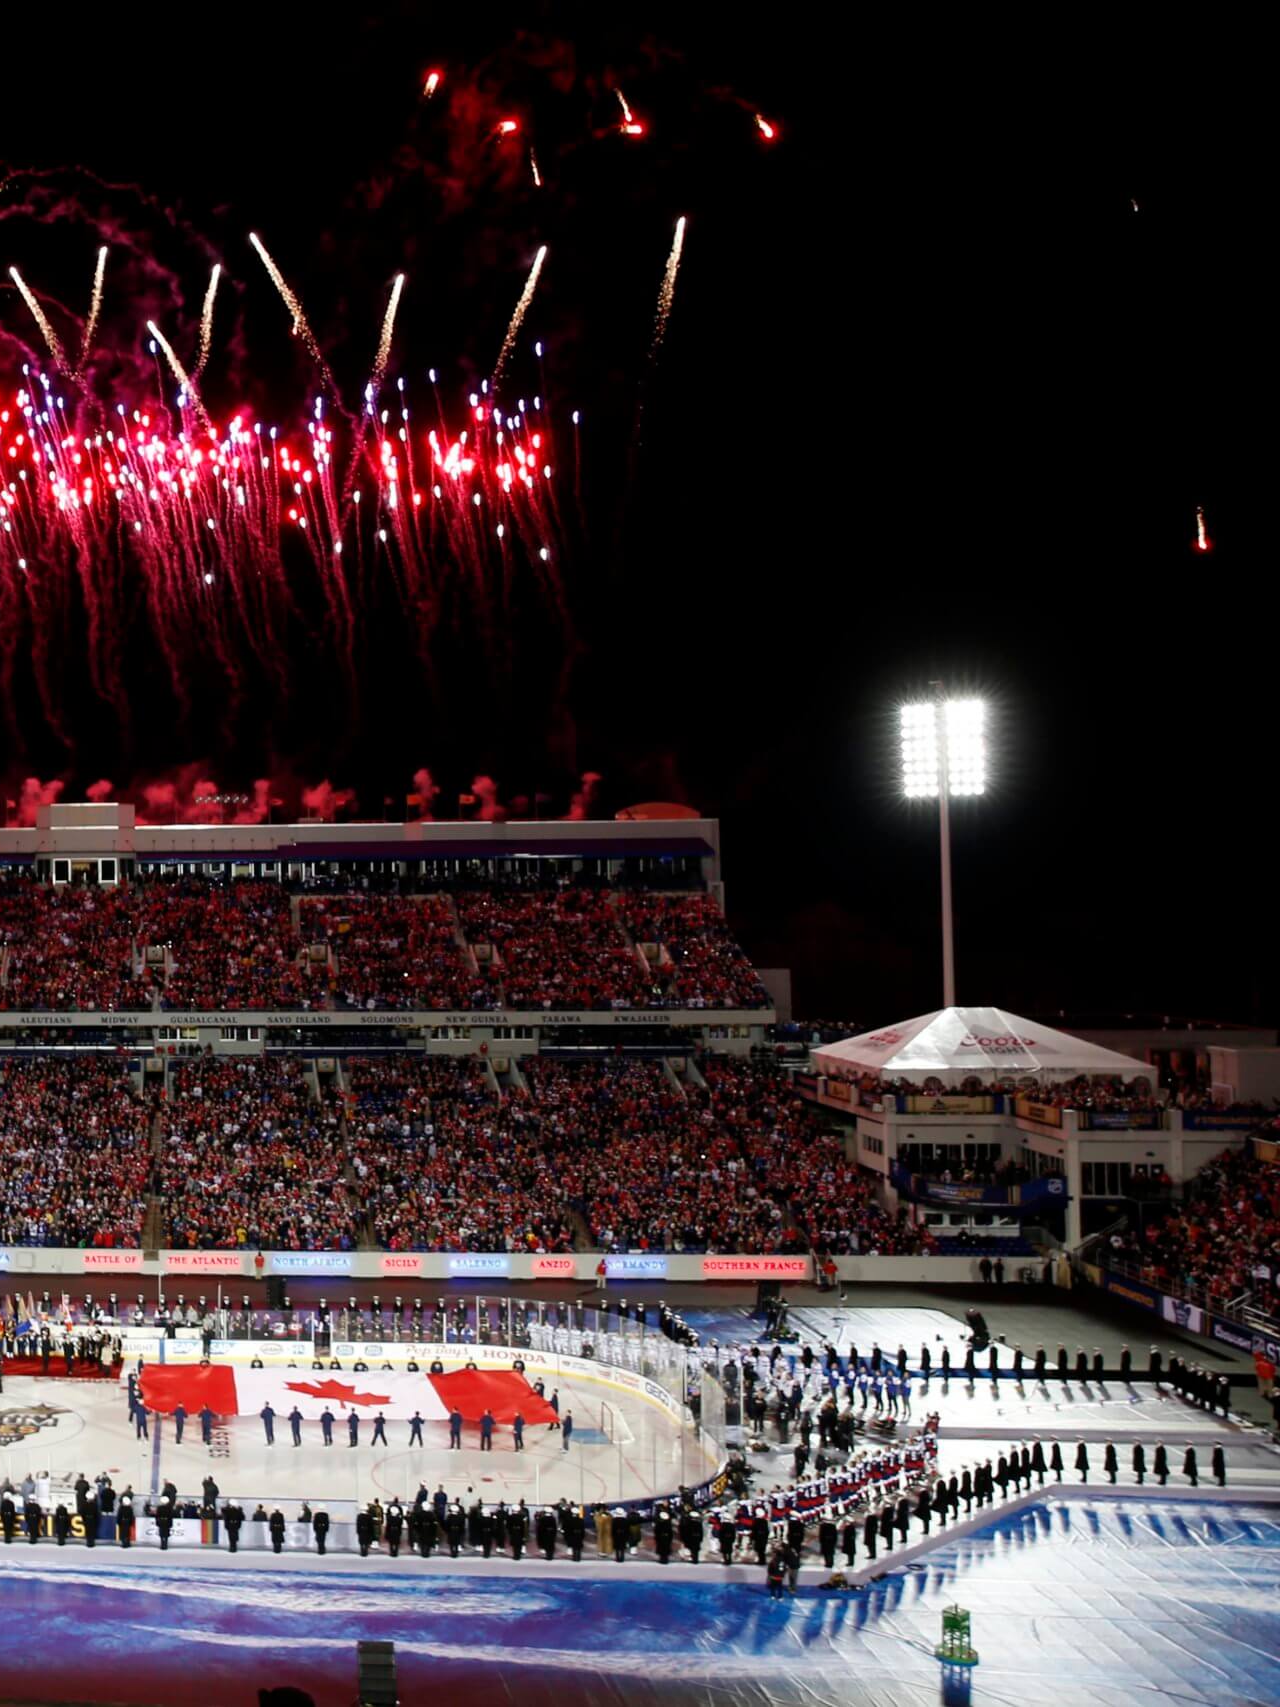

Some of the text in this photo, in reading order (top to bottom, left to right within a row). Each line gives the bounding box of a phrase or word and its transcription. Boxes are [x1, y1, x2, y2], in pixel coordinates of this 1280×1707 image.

[21, 1016, 72, 1024] ALEUTIANS
[101, 1016, 139, 1024] MIDWAY
[171, 1016, 238, 1024] GUADALCANAL
[268, 1016, 331, 1024] SAVO ISLAND
[361, 1016, 413, 1024] SOLOMONS
[446, 1015, 508, 1023] NEW GUINEA
[542, 1015, 581, 1023] TARAWA
[614, 1015, 670, 1023] KWAJALEIN
[85, 1255, 239, 1266] BATTLE OF THE ATLANTIC
[275, 1257, 348, 1267] NORTH AFRICA
[385, 1259, 418, 1268] SICILY
[456, 1260, 502, 1268] SALERNO
[539, 1260, 571, 1269] ANZIO
[704, 1261, 804, 1271] SOUTHERN FRANCE
[482, 1349, 547, 1365] HONDA
